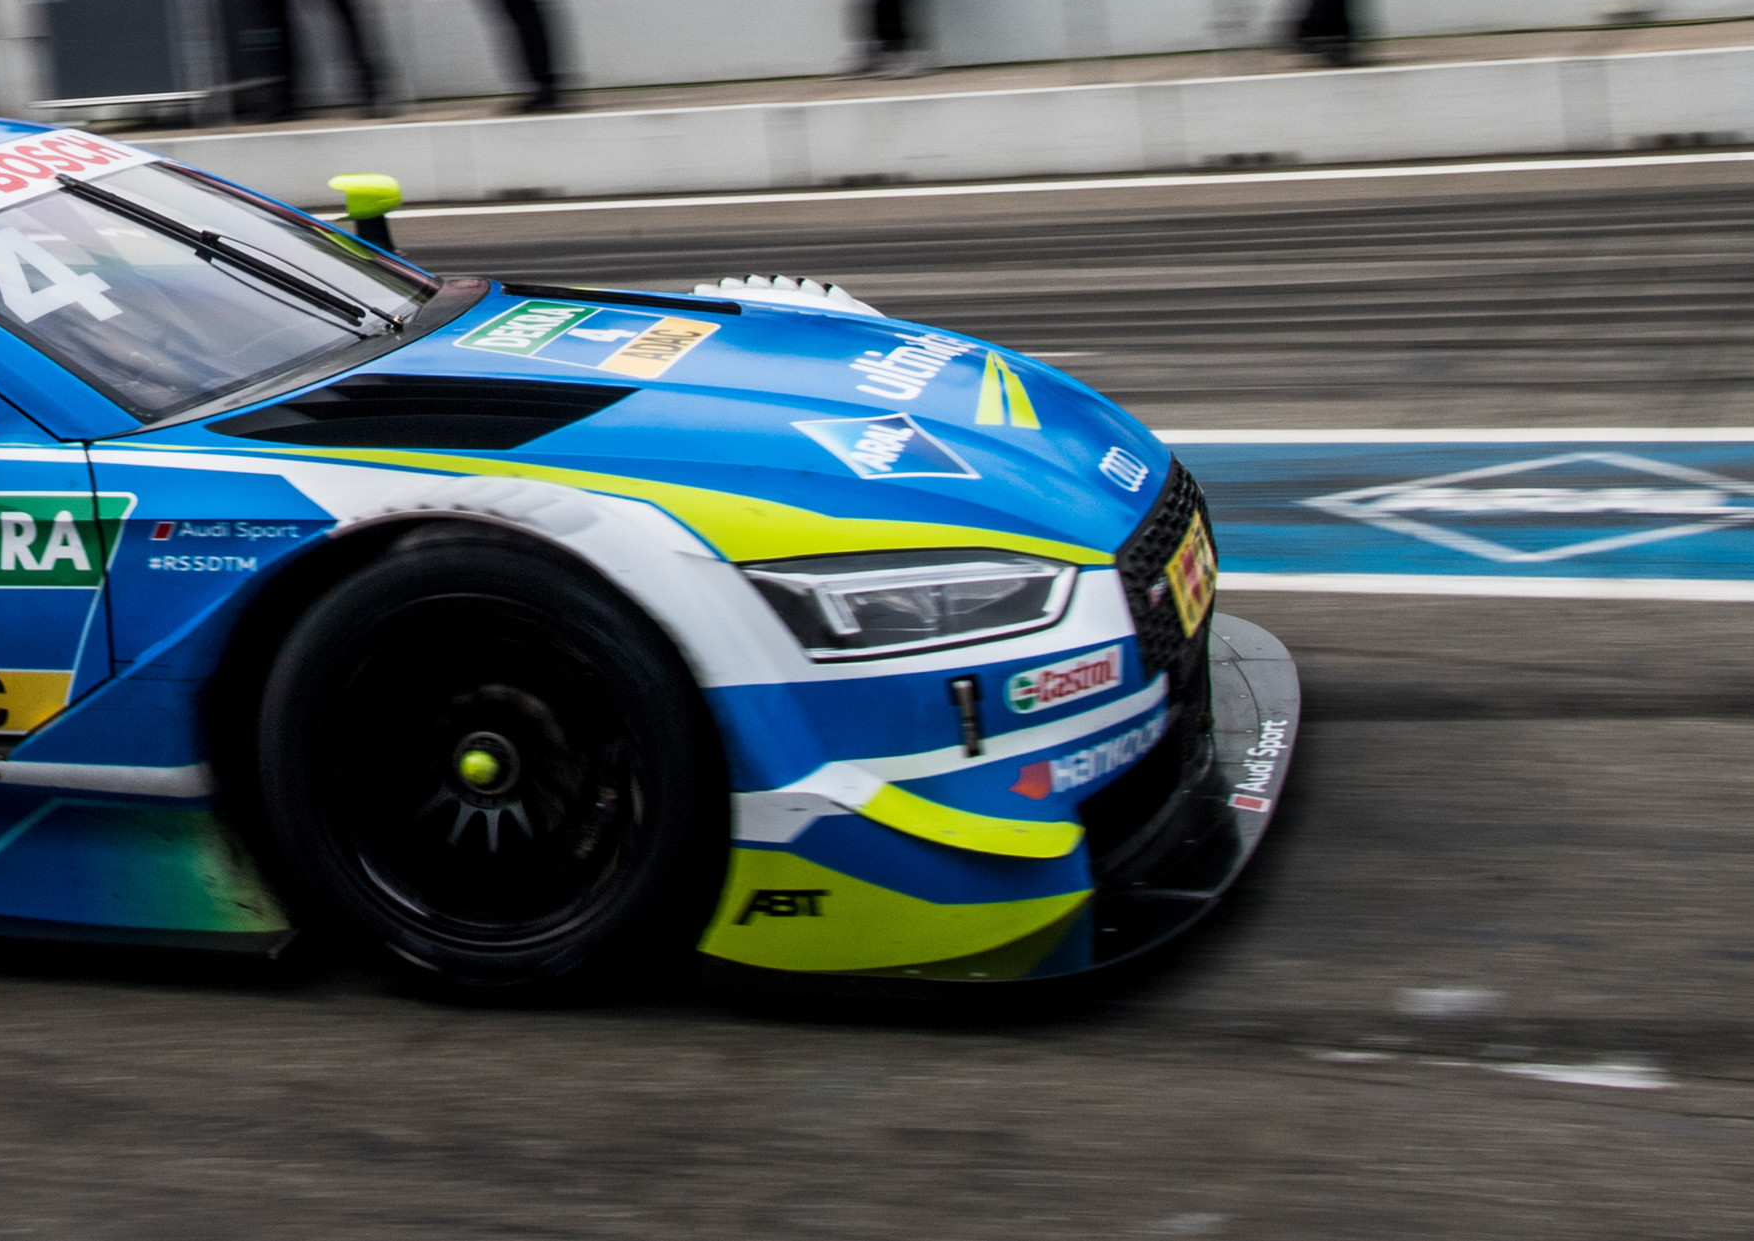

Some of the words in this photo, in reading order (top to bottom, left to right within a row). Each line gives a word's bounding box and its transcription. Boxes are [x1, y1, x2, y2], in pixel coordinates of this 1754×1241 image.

[472, 306, 586, 348] DEKRA
[567, 328, 639, 342] 4
[620, 329, 702, 362] ADAC
[849, 424, 916, 472] ARAL
[178, 521, 231, 537] Audi
[233, 521, 302, 542] Sport
[1037, 652, 1120, 703] Castrol
[1247, 720, 1289, 758] Sport
[1233, 759, 1276, 793] Audi
[730, 889, 833, 925] ABT
